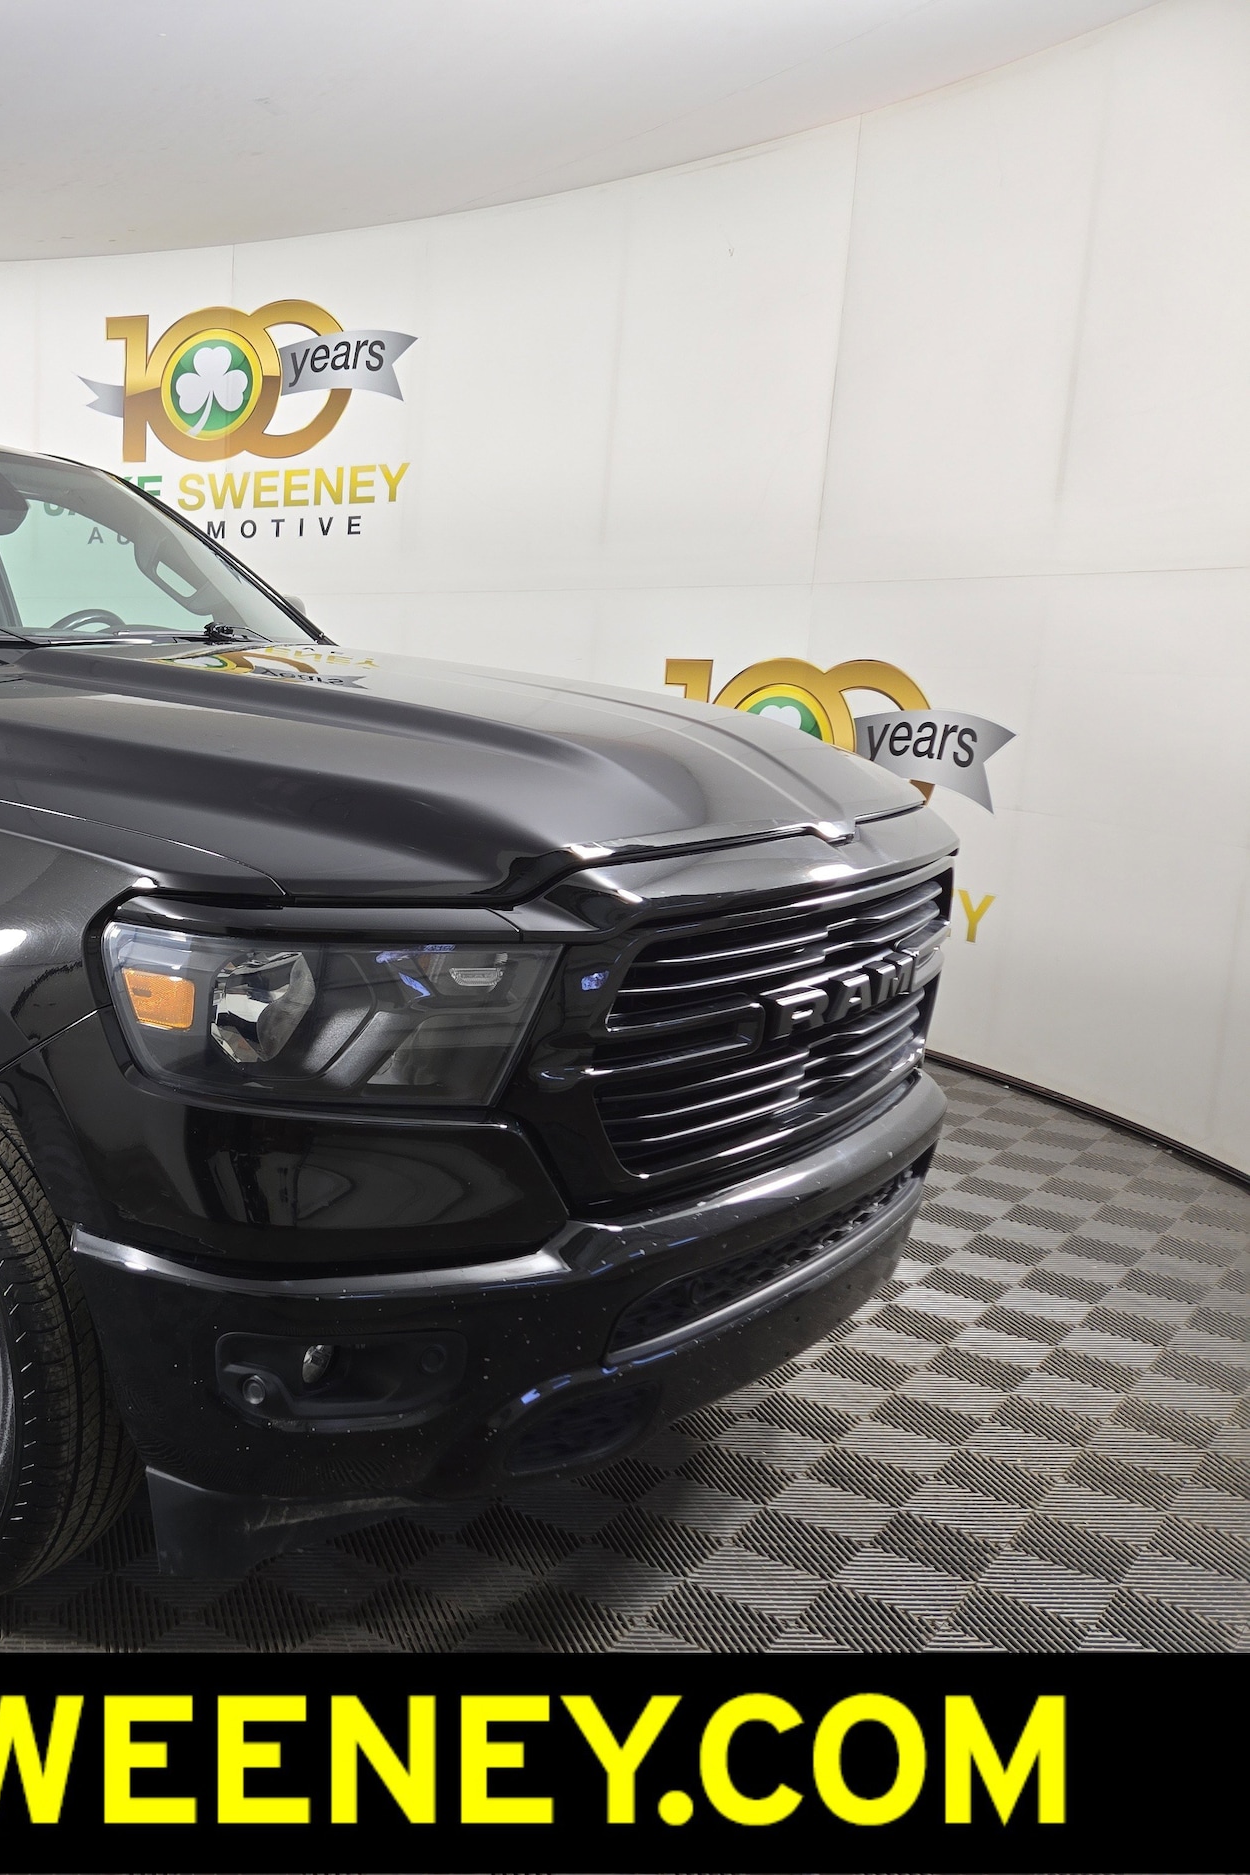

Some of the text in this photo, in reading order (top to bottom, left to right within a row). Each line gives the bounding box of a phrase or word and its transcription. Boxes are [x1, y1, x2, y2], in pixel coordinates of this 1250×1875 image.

[288, 338, 386, 388] years
[177, 462, 410, 511] SWEENEY
[867, 720, 979, 768] years
[770, 952, 916, 1038] RAM
